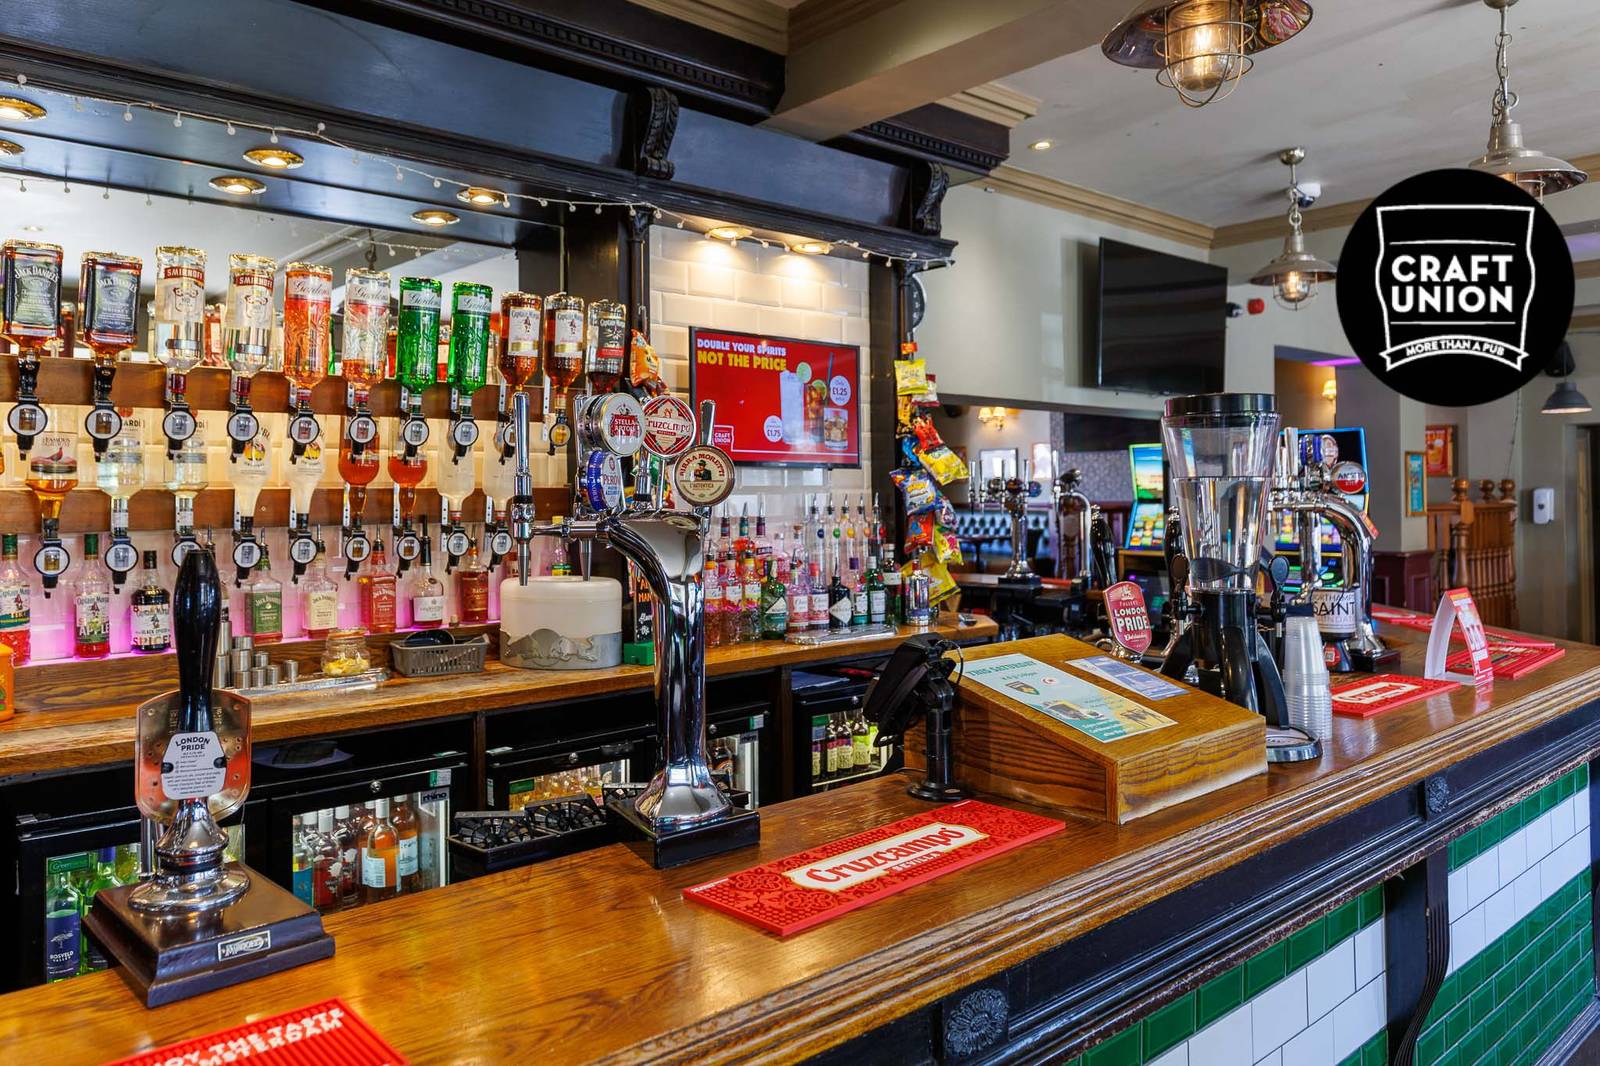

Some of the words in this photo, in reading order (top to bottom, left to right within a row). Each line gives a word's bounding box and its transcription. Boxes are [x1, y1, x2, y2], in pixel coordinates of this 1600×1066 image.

[14, 267, 33, 279] JACK
[167, 267, 203, 280] SMIRNOFF
[239, 275, 273, 290] SMIRNOFF
[697, 338, 730, 350] DOUBLE
[731, 342, 755, 352] YOUR
[756, 346, 787, 356] SPIRITS
[697, 350, 724, 364] NOT
[728, 355, 750, 367] THE
[753, 356, 787, 371] PRICE
[832, 386, 848, 396] £1.25
[614, 418, 637, 426] STELLA
[647, 420, 692, 433] ruzcampo
[767, 428, 782, 438] £1.75
[679, 455, 698, 477] BIRRA
[698, 453, 726, 477] MORETTI
[1114, 606, 1146, 617] LONDON
[1116, 616, 1150, 633] PRIDE
[175, 736, 211, 747] LONDON
[181, 743, 206, 751] PRIDE
[423, 791, 448, 802] rhino
[806, 827, 964, 883] Cruzcampo
[893, 850, 942, 873] SEVILLA
[49, 950, 75, 960] BOSVELD
